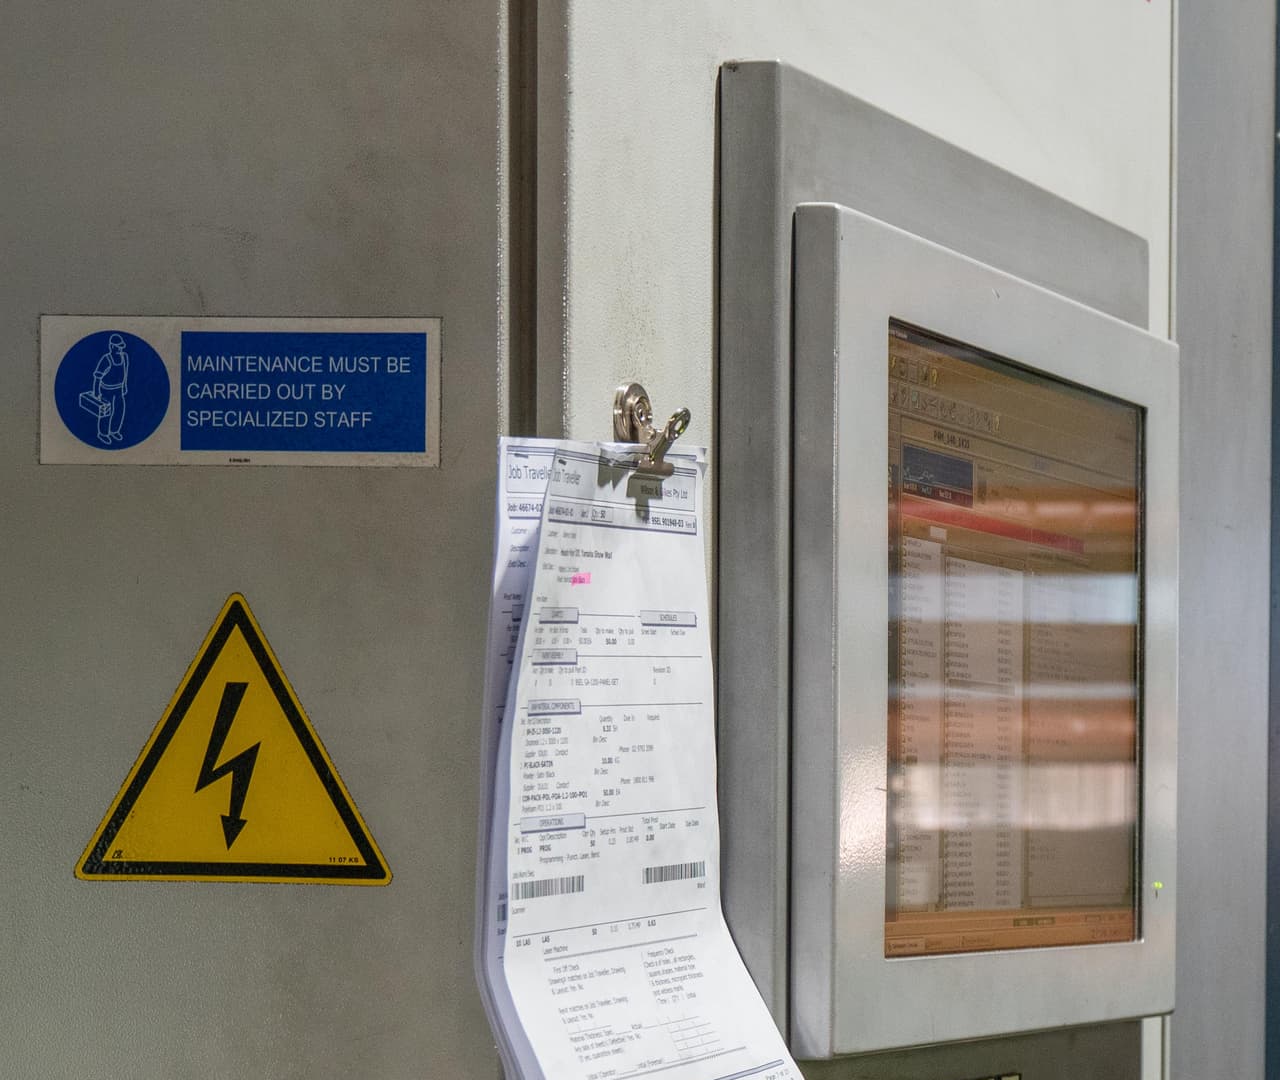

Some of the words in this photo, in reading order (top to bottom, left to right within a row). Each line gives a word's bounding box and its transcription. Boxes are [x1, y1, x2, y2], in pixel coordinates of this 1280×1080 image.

[187, 355, 325, 374] MAINTENANCE
[329, 356, 383, 374] MUST
[387, 356, 411, 374] BE
[187, 383, 272, 400] CARRIED
[277, 383, 316, 401] OUT
[322, 384, 346, 401] BY
[187, 410, 309, 428] SPECIALIZED
[313, 411, 373, 429] STAFF
[508, 464, 521, 479] Job
[523, 465, 552, 481] Travelle
